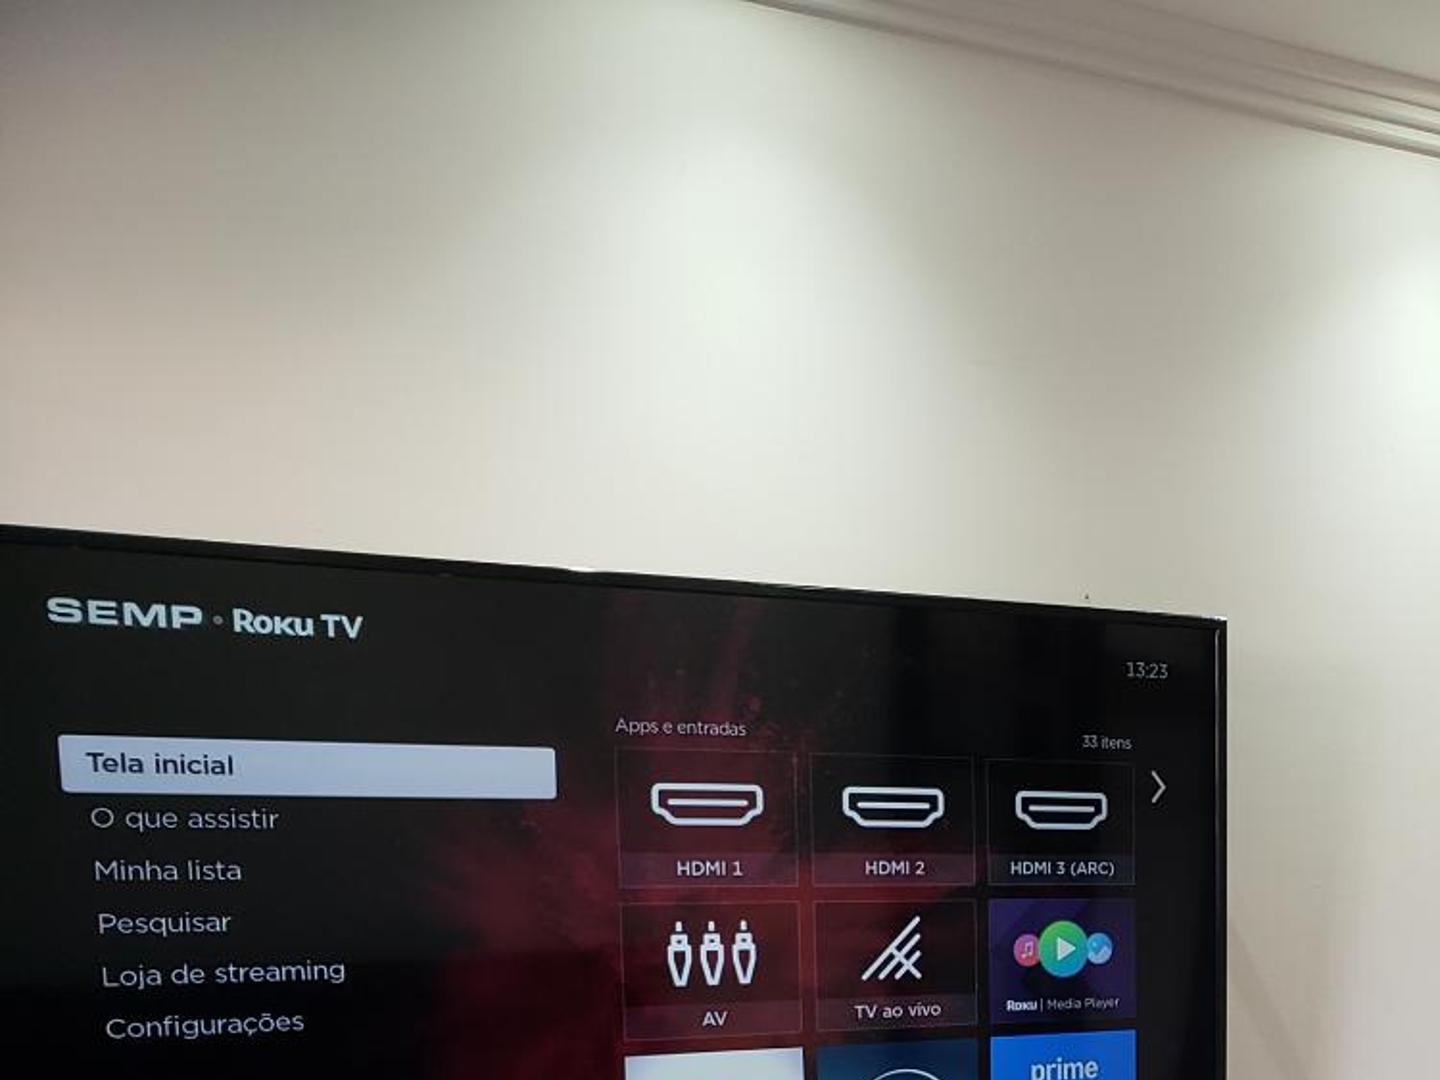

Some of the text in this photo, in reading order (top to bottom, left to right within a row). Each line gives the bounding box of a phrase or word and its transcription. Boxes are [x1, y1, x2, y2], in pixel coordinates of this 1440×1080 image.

[47, 597, 201, 629] SEMP
[321, 614, 363, 639] TV
[1127, 661, 1168, 680] 13:23
[615, 718, 747, 737] Apps e entradas
[1082, 735, 1132, 751] 33 itens
[86, 752, 234, 777] Tela inicial
[91, 808, 279, 833] O que assistir
[94, 860, 241, 883] Minha lista
[677, 861, 742, 877] HDMI 1
[865, 861, 925, 876] HDMI 2
[1011, 860, 1115, 878] HDMI 3 (ARC)
[98, 912, 231, 938] Pesquisar
[102, 961, 345, 989] Loja de streaming
[702, 1011, 728, 1026] AV
[855, 1003, 941, 1021] TV ao vivo
[106, 1012, 304, 1040] Configurações
